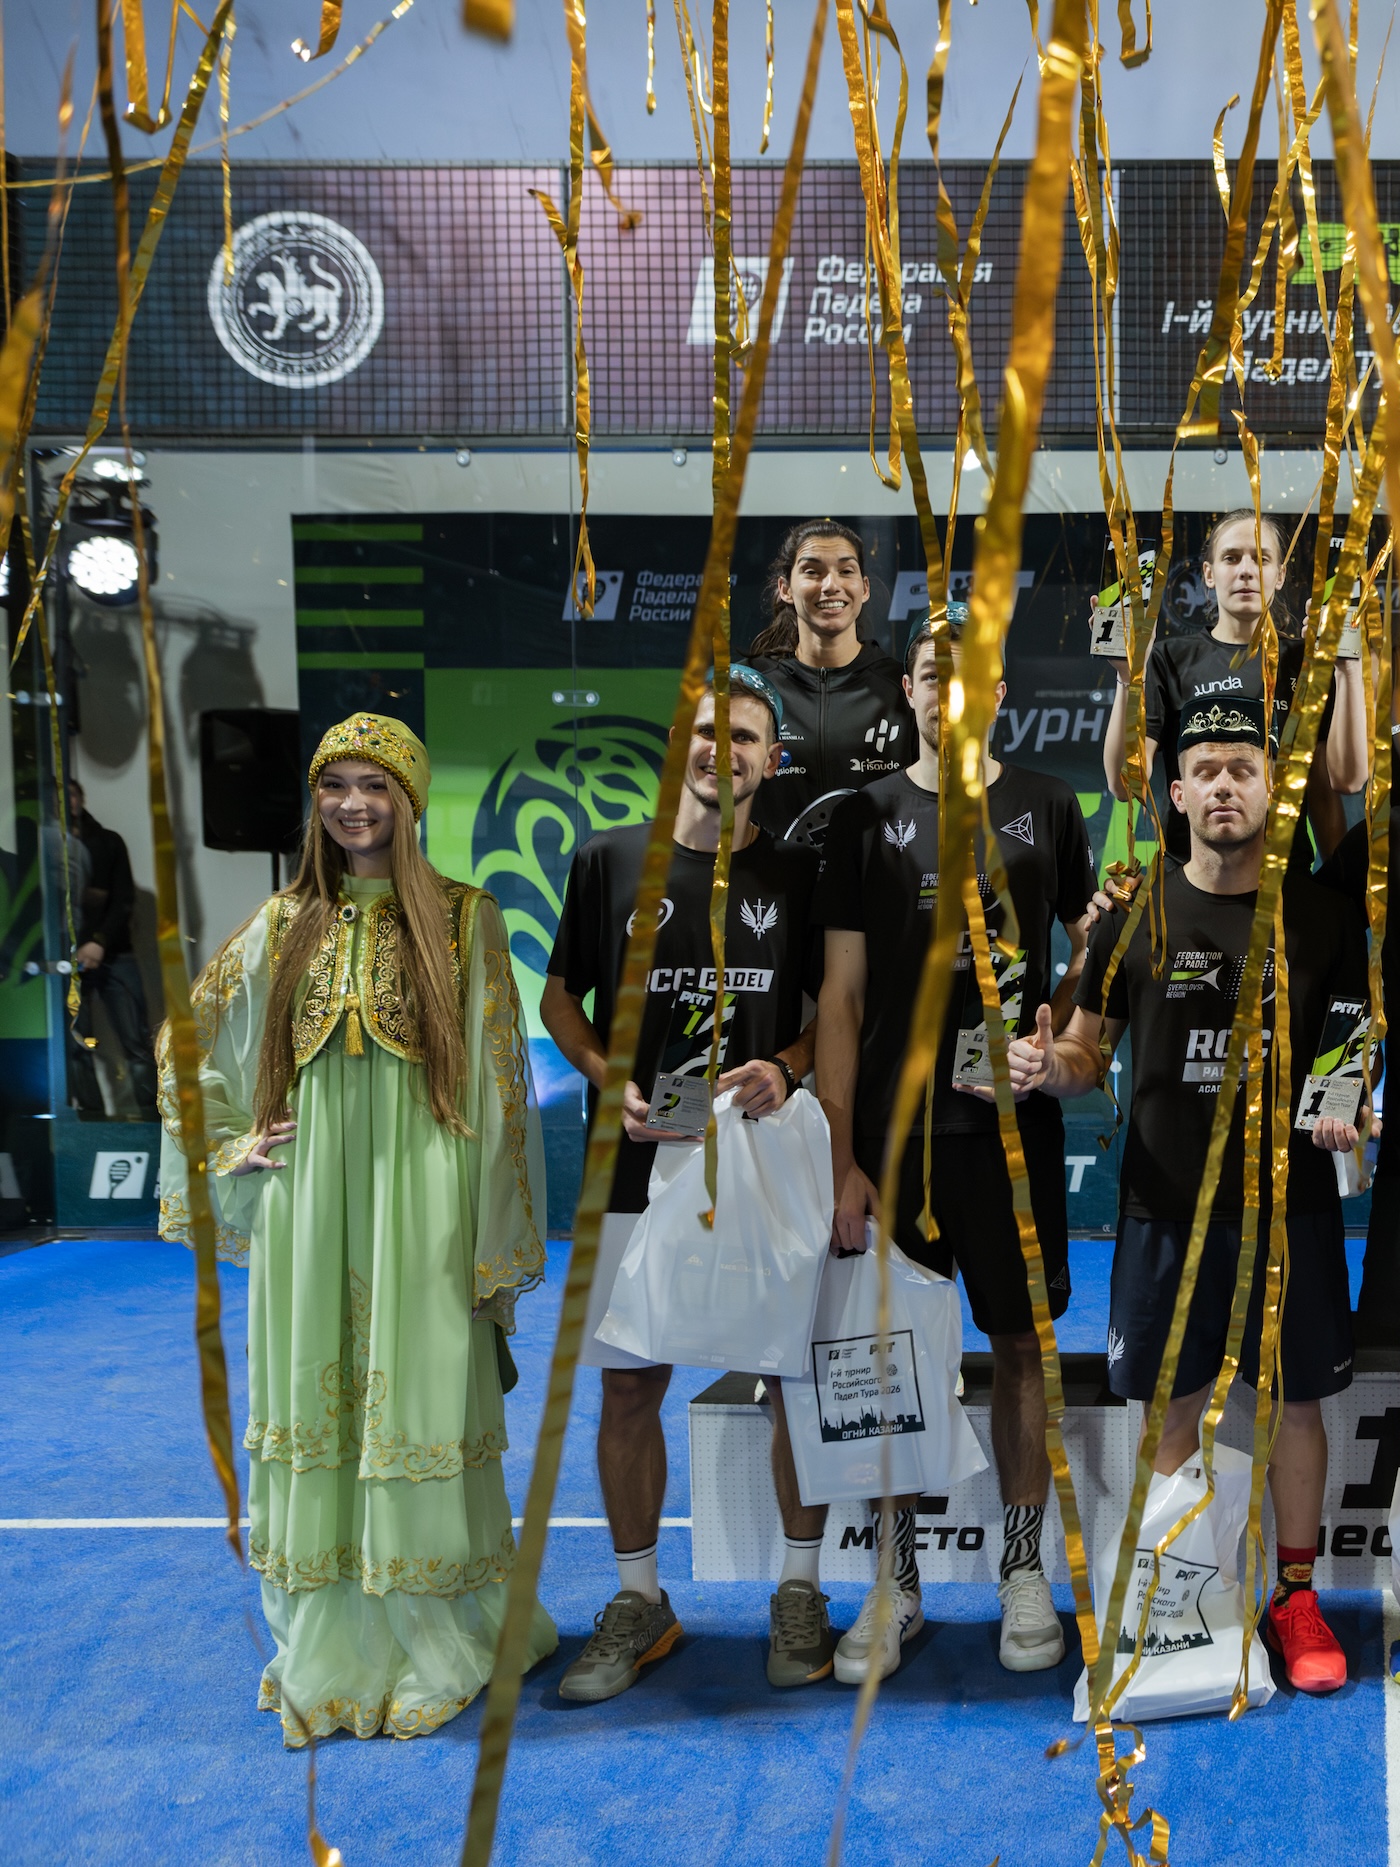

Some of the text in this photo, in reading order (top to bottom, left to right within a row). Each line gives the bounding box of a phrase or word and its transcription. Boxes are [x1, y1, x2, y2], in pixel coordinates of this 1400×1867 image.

[629, 606, 691, 621] России
[1176, 951, 1223, 960] FEDERATION
[1174, 960, 1209, 969] OF PADEL
[1166, 991, 1187, 999] REGION
[860, 1389, 879, 1399] Тура
[842, 1423, 903, 1440] ОГНИ КАЗАНИ
